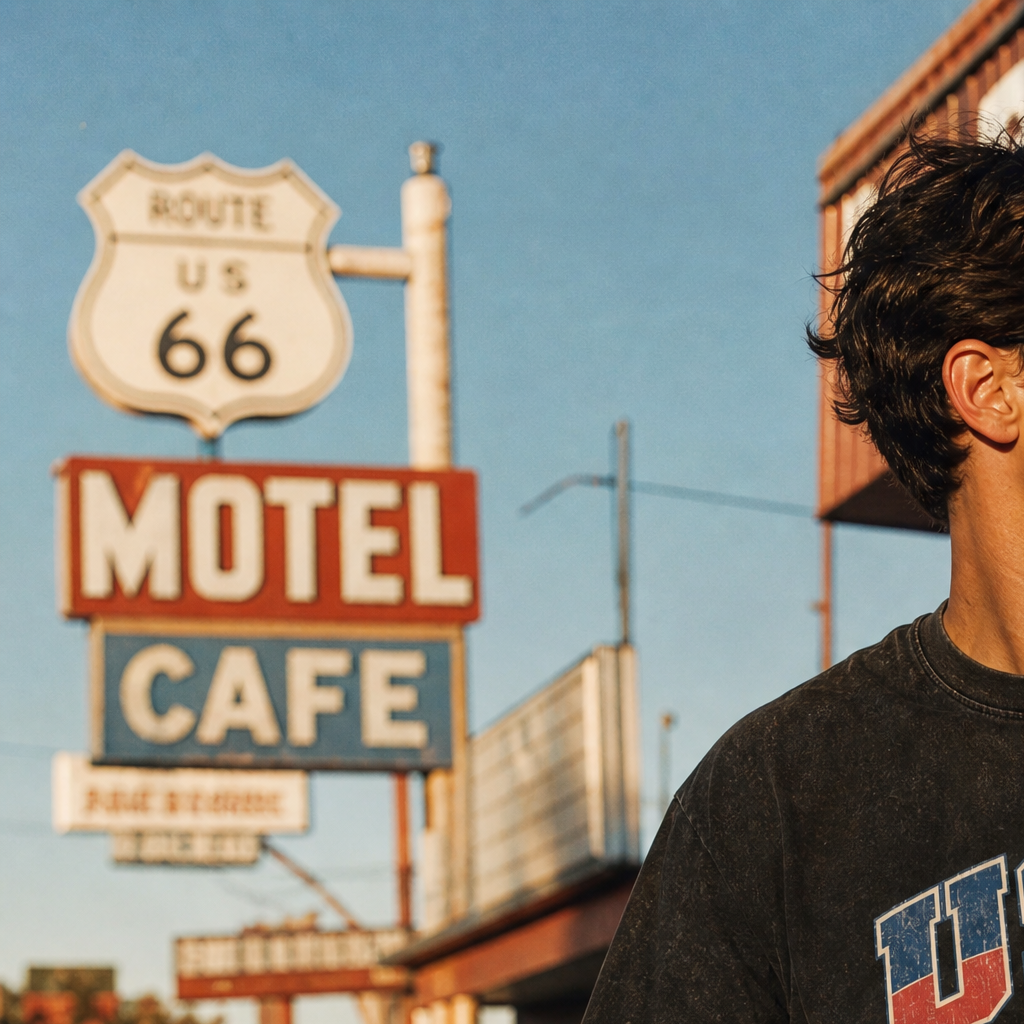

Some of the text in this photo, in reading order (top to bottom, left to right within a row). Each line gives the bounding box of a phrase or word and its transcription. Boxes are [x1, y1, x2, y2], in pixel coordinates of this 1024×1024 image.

[149, 190, 271, 231] ROUTE
[157, 309, 272, 381] 66
[79, 469, 472, 606] MOTEL
[119, 644, 428, 748] CAFE
